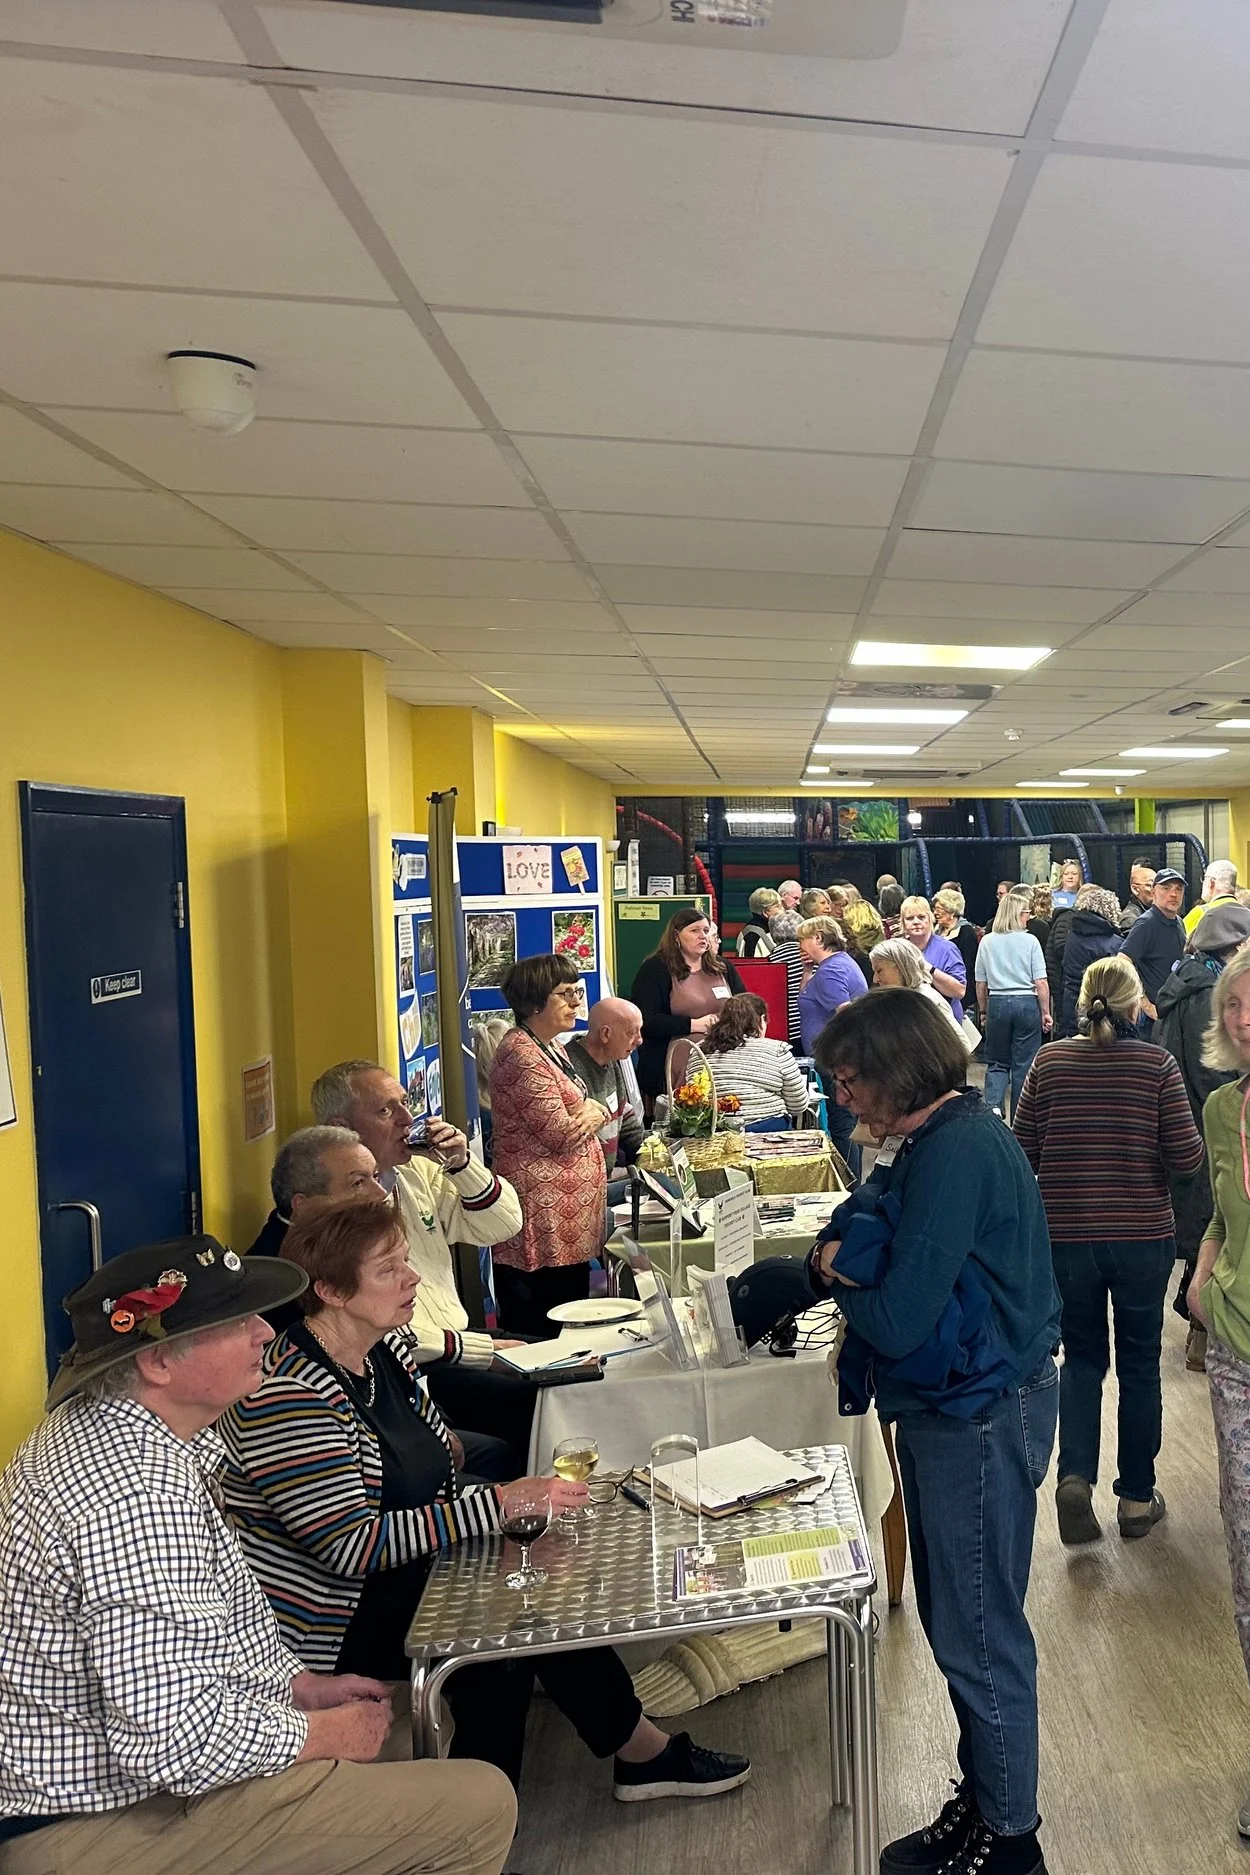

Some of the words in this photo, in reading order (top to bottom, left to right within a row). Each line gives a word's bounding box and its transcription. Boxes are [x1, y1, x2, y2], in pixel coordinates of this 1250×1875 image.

[506, 862, 550, 879] LOVE
[105, 978, 120, 992] Keep
[122, 975, 136, 988] clear
